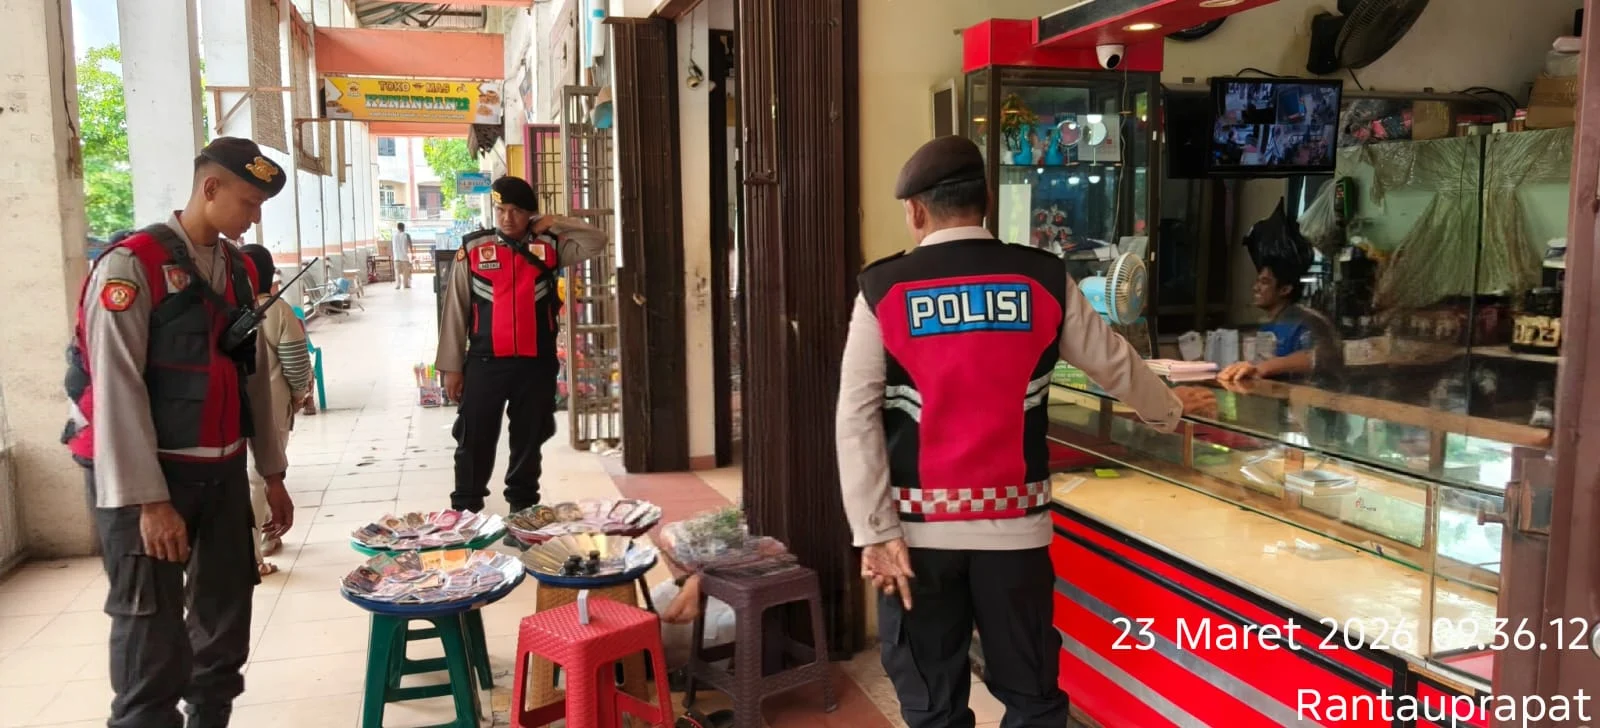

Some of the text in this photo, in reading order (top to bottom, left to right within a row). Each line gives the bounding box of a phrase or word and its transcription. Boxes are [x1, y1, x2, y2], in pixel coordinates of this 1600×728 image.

[378, 81, 450, 93] TOKO MAS
[910, 290, 1029, 328] POLISI
